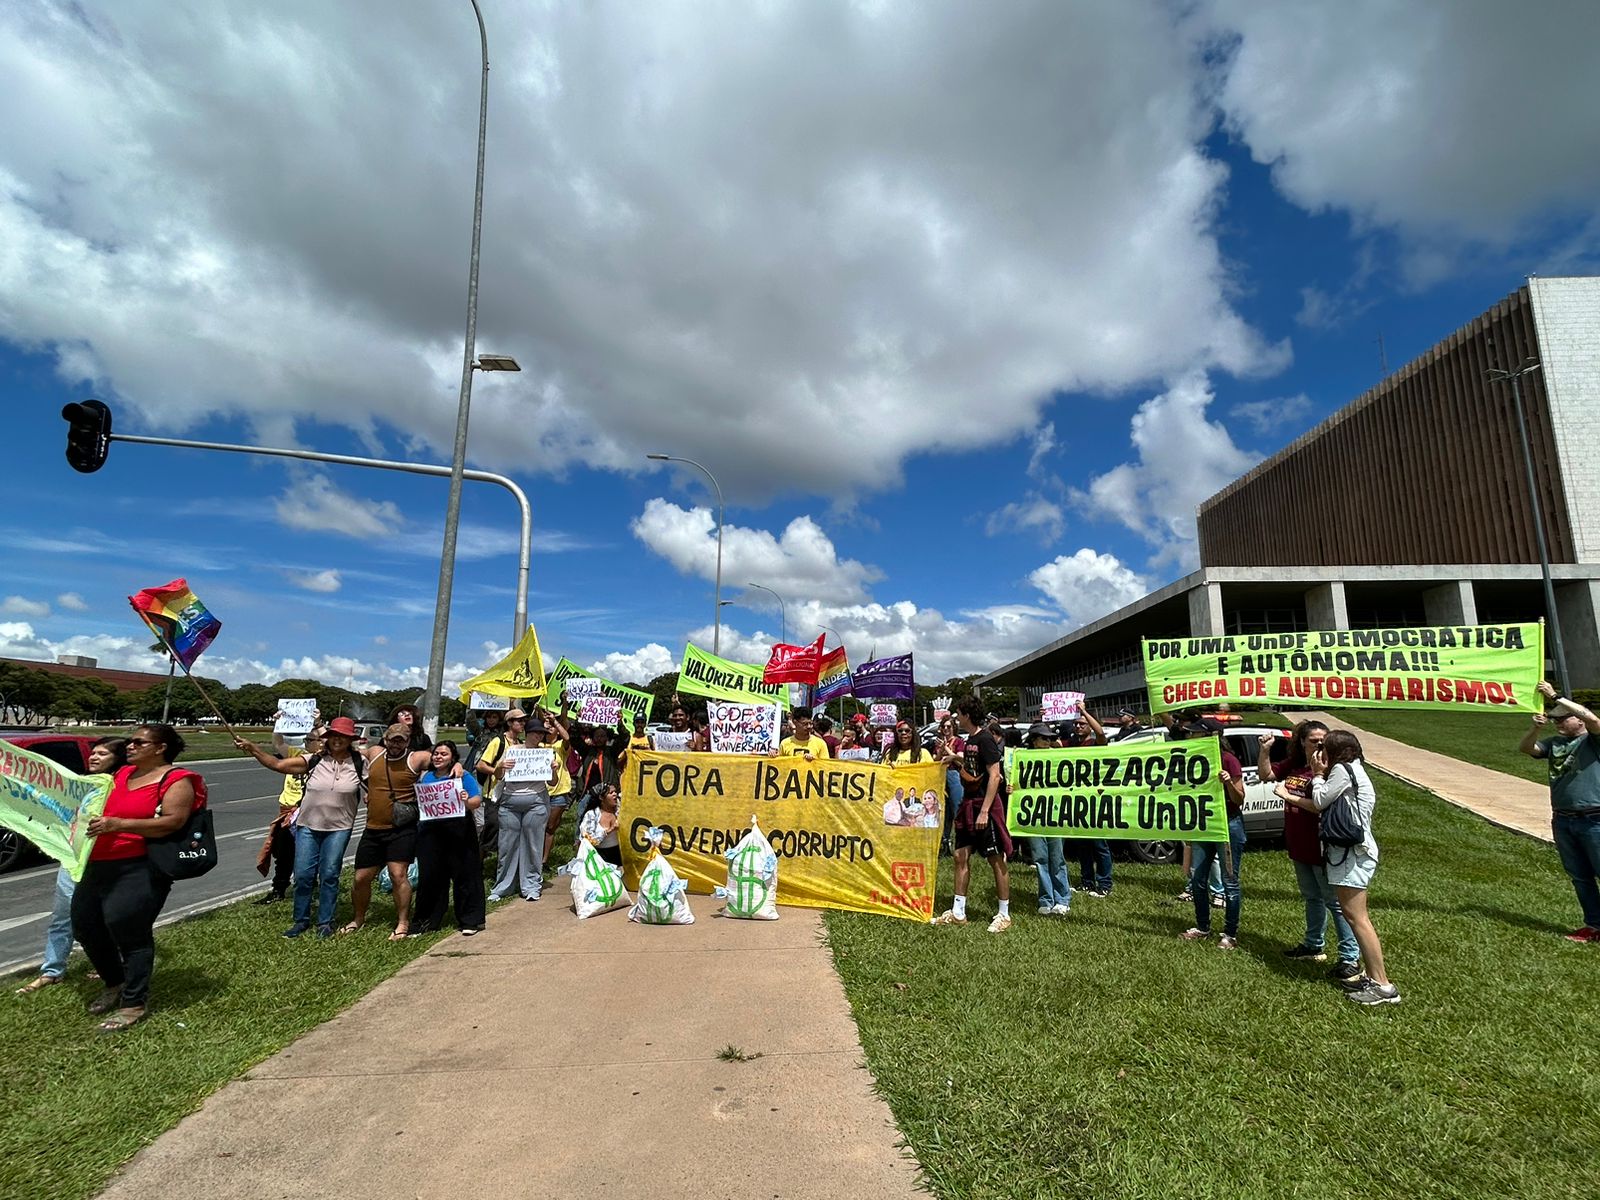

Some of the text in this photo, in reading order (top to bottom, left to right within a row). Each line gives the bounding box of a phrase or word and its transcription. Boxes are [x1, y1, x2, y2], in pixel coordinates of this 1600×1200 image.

[1149, 641, 1181, 661] POR
[1188, 637, 1236, 656] UMA
[1248, 634, 1308, 650] UnDF
[684, 657, 744, 692] VALORIZA
[1218, 650, 1441, 676] E AUTÔNOMA!!!
[818, 669, 848, 689] ANDES
[1163, 676, 1519, 705] CHEGA DE AUTORITARISMO!
[716, 706, 753, 721] GDF
[638, 760, 876, 802] FORA IBANEIS!
[1018, 747, 1210, 792] VALORIZAÇÃO
[419, 793, 439, 803] DADE
[421, 781, 455, 795] UNIVERSI
[423, 788, 461, 817] NOSSA!
[1016, 794, 1214, 831] SALARIAL UnDF
[1251, 799, 1284, 812] MILITAR
[630, 817, 874, 863] GOVERN CORRUPTO
